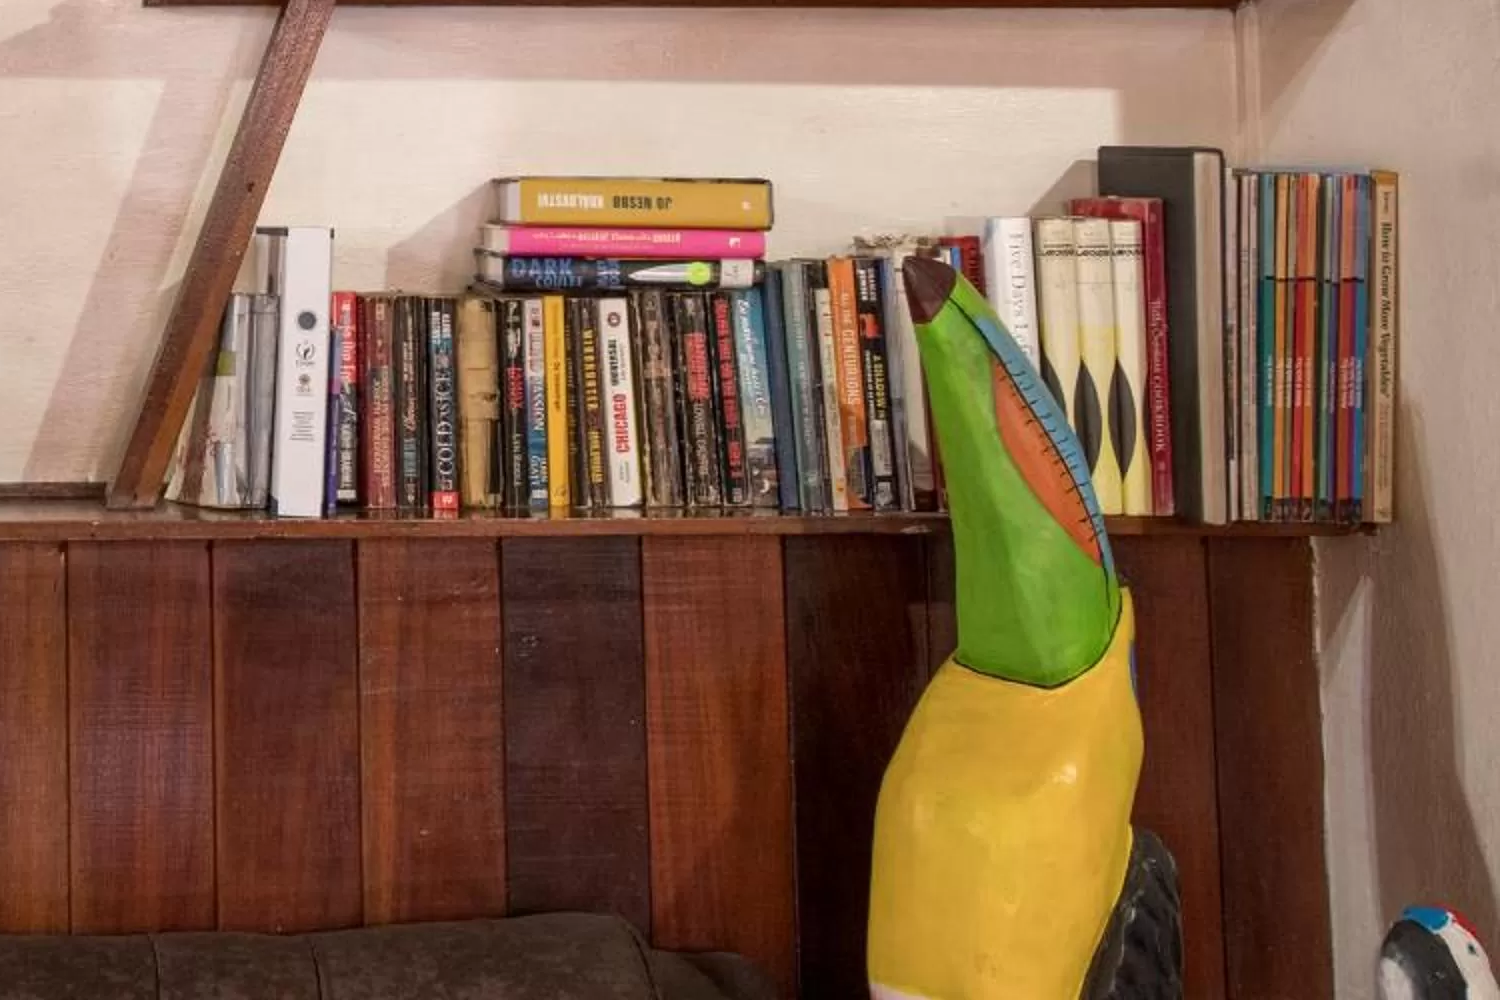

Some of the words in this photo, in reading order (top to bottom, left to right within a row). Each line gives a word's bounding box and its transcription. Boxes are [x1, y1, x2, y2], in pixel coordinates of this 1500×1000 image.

[656, 196, 672, 209] JO
[1010, 232, 1026, 268] Five
[1380, 222, 1392, 249] How
[510, 258, 572, 278] DARK
[1381, 251, 1392, 263] to
[1009, 275, 1027, 316] Days
[1380, 265, 1392, 297] Grow
[1380, 299, 1392, 330] More
[435, 368, 452, 401] ICE
[841, 329, 861, 406] CENTURIONS
[874, 363, 885, 408] SHADOW
[532, 377, 545, 430] PASSION
[1153, 375, 1166, 452] COOKBOOK
[612, 393, 631, 454] CHICAGO
[436, 423, 453, 476] COLD
